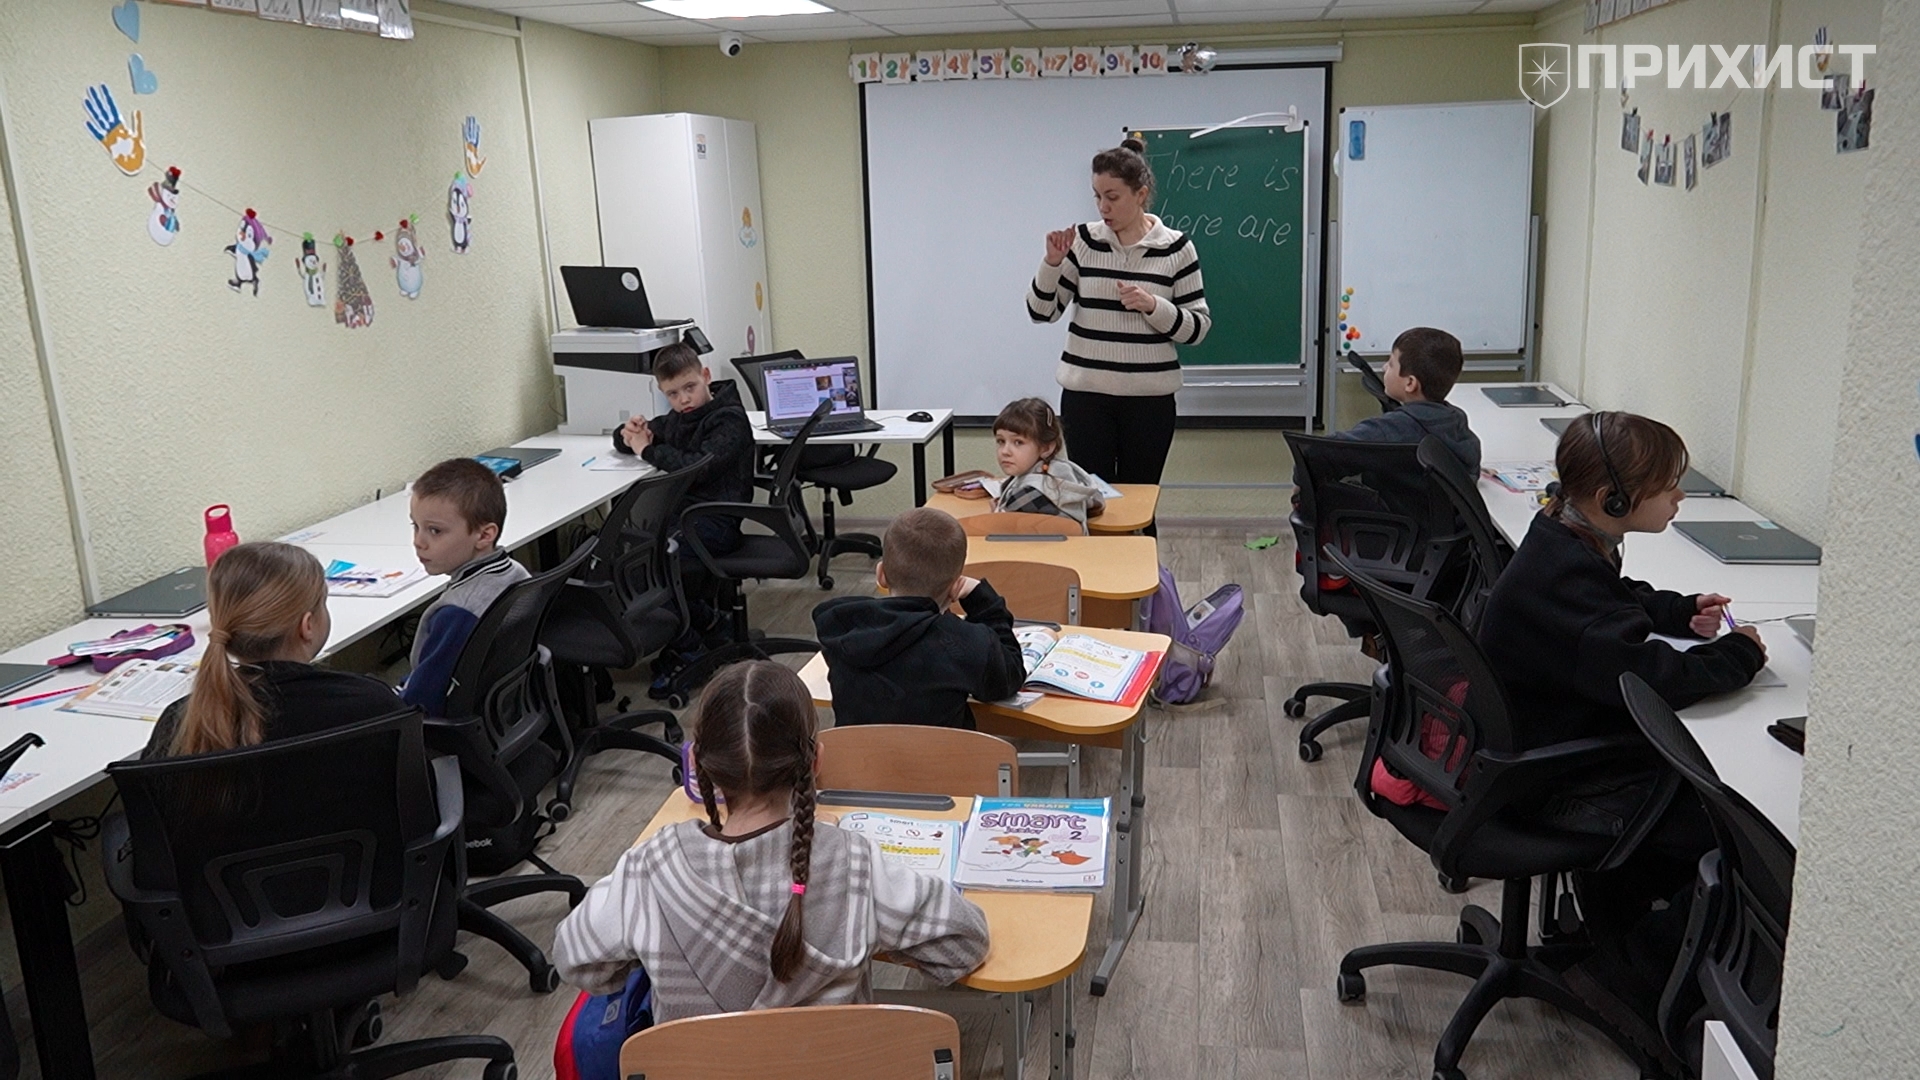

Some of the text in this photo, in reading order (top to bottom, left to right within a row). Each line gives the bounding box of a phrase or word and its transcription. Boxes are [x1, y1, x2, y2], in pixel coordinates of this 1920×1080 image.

[857, 52, 1161, 79] 1 2 3 4 5 6 7 8 9 10
[1146, 150, 1299, 192] There is
[1157, 198, 1292, 246] here are
[980, 811, 1087, 831] smart
[1069, 830, 1082, 841] 2
